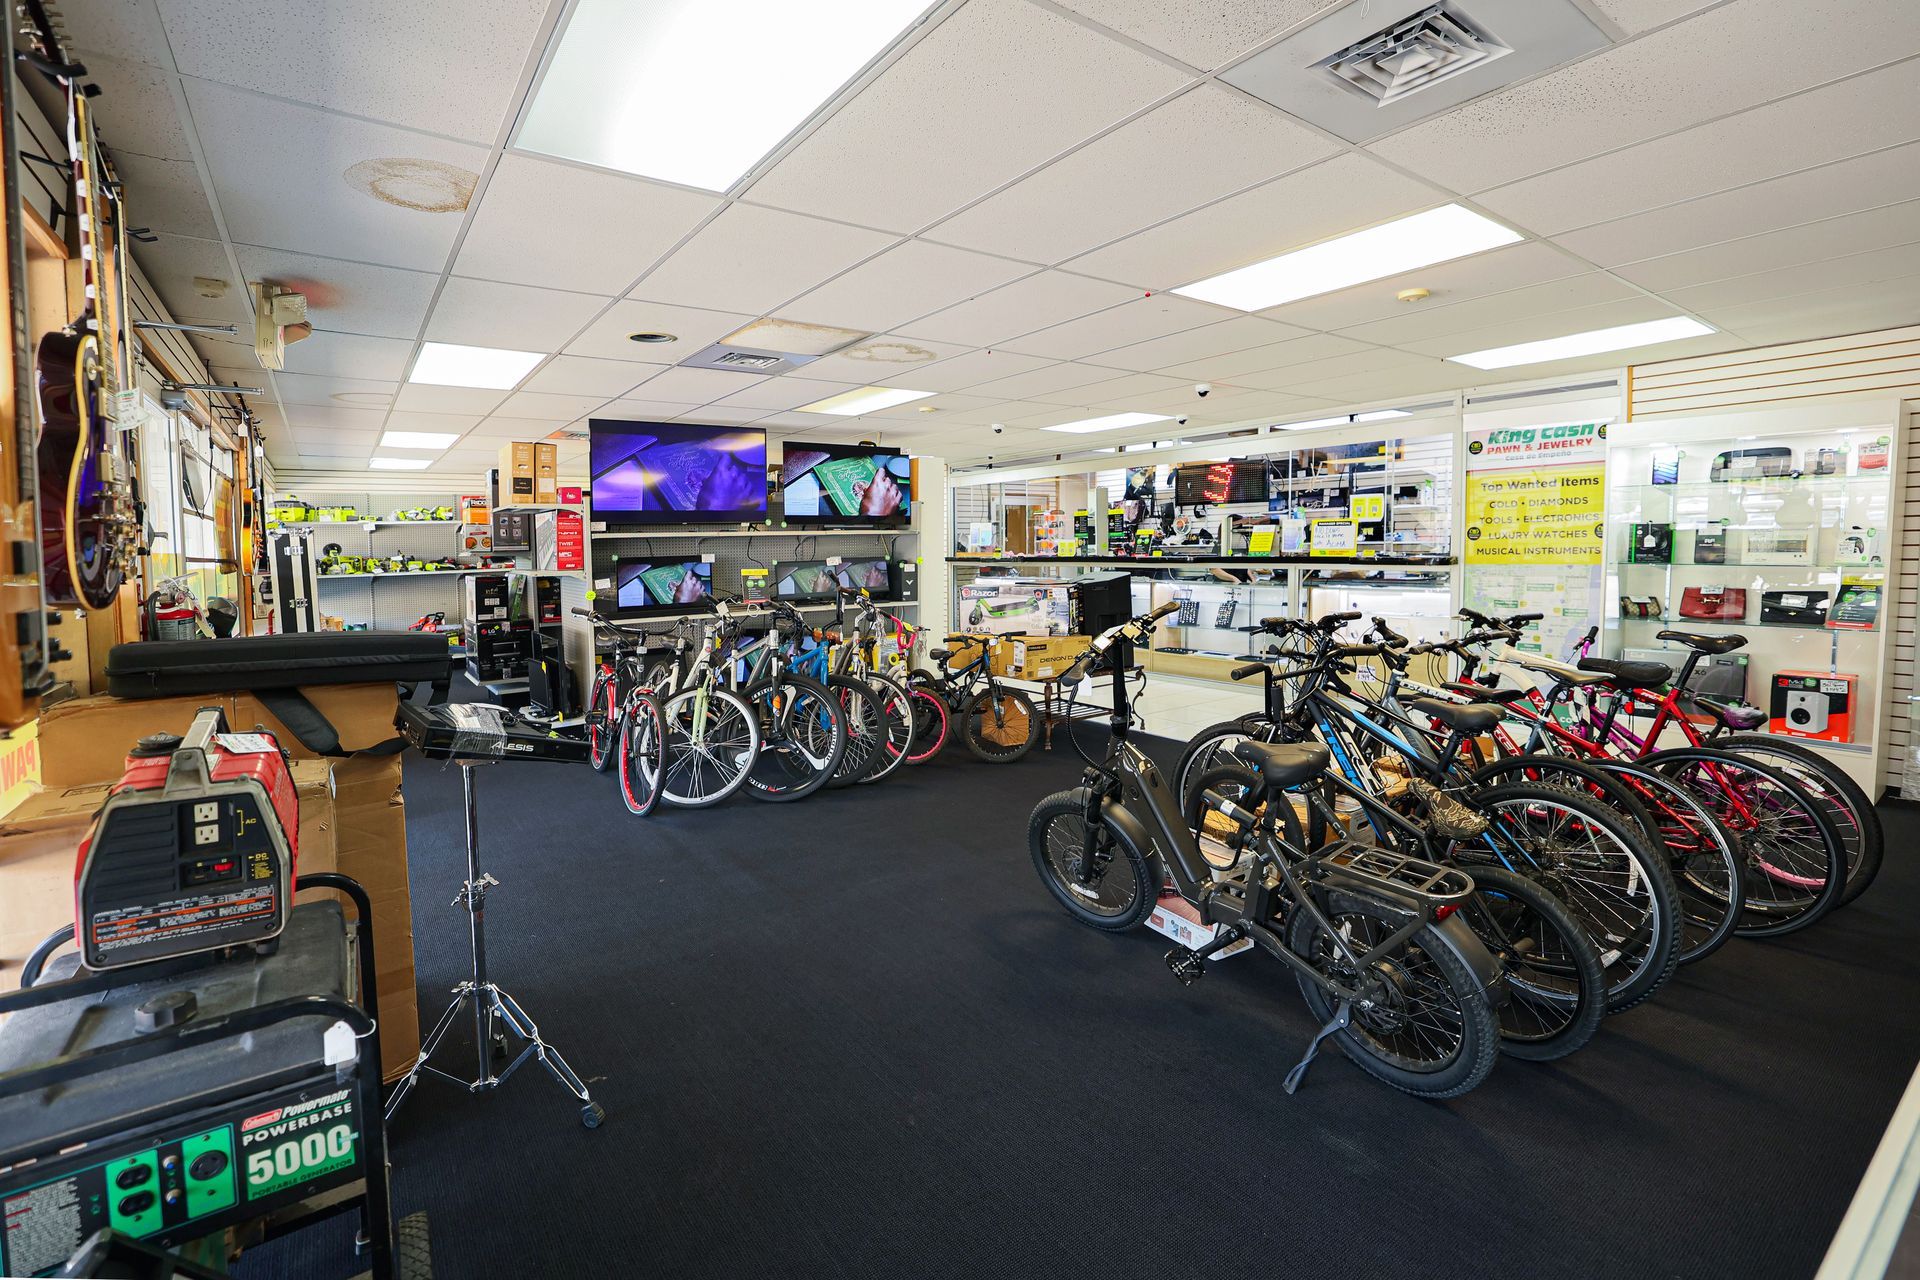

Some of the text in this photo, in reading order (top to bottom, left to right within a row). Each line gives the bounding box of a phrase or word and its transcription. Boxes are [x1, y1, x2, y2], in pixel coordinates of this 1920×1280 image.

[1487, 428, 1536, 444] King
[1488, 444, 1520, 455] PAWN
[1537, 437, 1594, 451] JEWELRY
[1481, 477, 1599, 492] Top Wanted Items
[1529, 497, 1588, 507] DIAMONDS
[1480, 513, 1600, 524] TOOLS ELECTRONICS
[1533, 530, 1588, 539] WATCHES
[1524, 546, 1601, 555] INSTRUMENTS
[970, 589, 998, 597] Razor
[490, 742, 534, 752] ALESIS
[1319, 718, 1364, 790] TREK
[282, 1089, 351, 1119] Powermate
[242, 1103, 352, 1147] POWERBASE
[248, 1124, 352, 1185] 5000
[252, 1158, 353, 1198] PORTABLE GENERATOR
